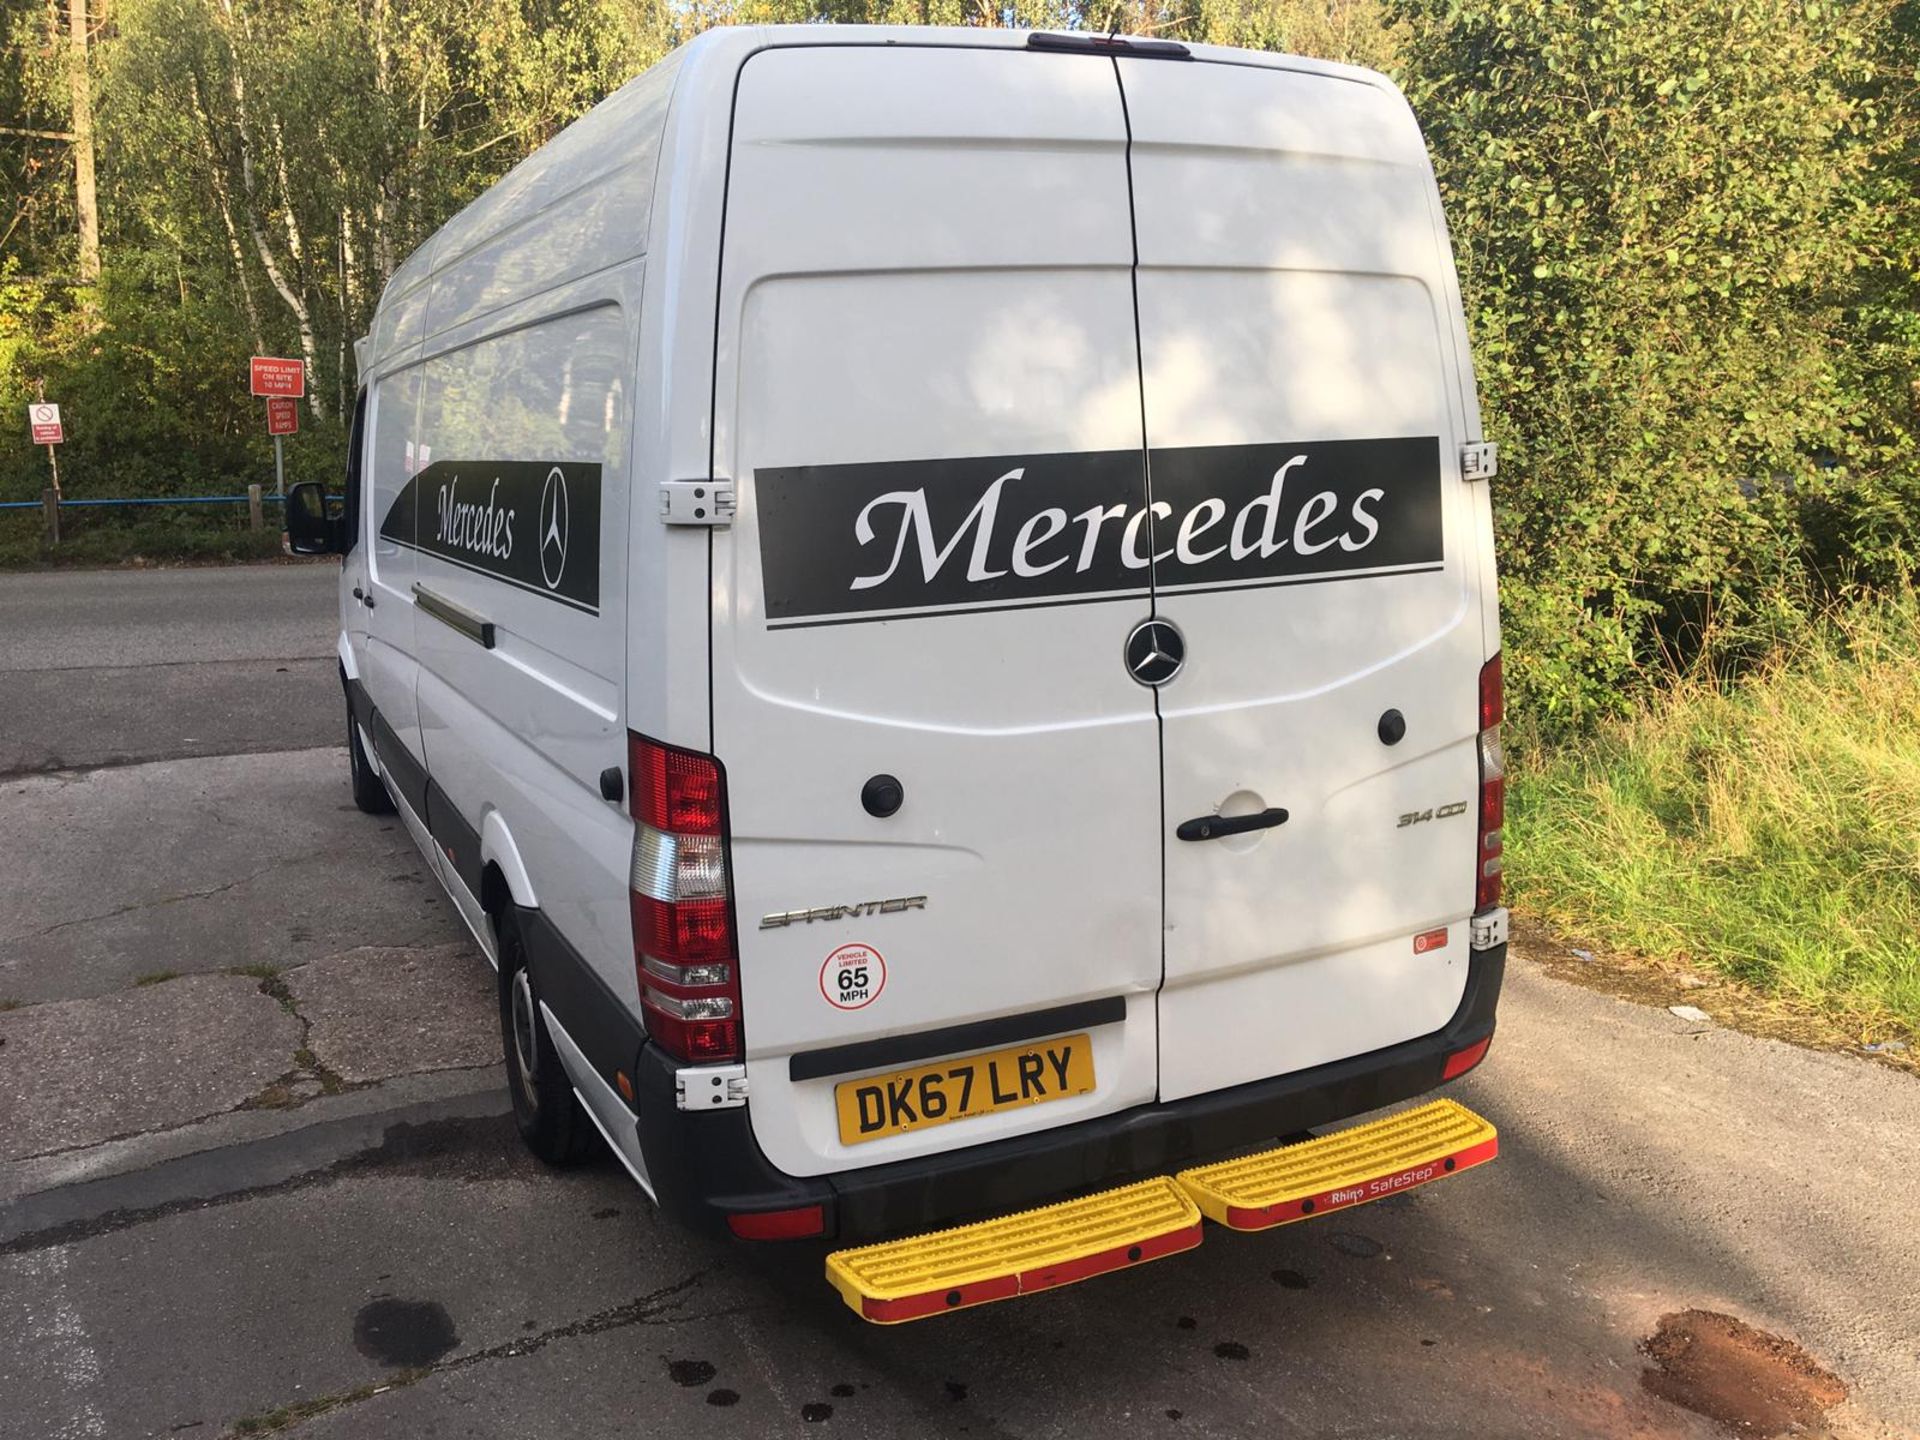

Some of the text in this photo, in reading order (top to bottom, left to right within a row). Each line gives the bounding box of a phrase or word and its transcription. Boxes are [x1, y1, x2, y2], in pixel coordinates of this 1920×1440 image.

[254, 365, 279, 373] SPEED
[275, 374, 293, 382] SITE
[436, 474, 516, 560] Mercedes
[849, 454, 1386, 591] Mercedes
[1396, 808, 1433, 828] 314
[759, 895, 928, 931] SPRINTER
[837, 951, 867, 961] VEHICLE
[839, 958, 868, 967] LIMITED
[837, 966, 869, 990] 65
[840, 989, 869, 1002] MPH
[856, 1046, 1071, 1134] DK67 LRY
[1332, 1167, 1433, 1204] Rhino SafeStep
